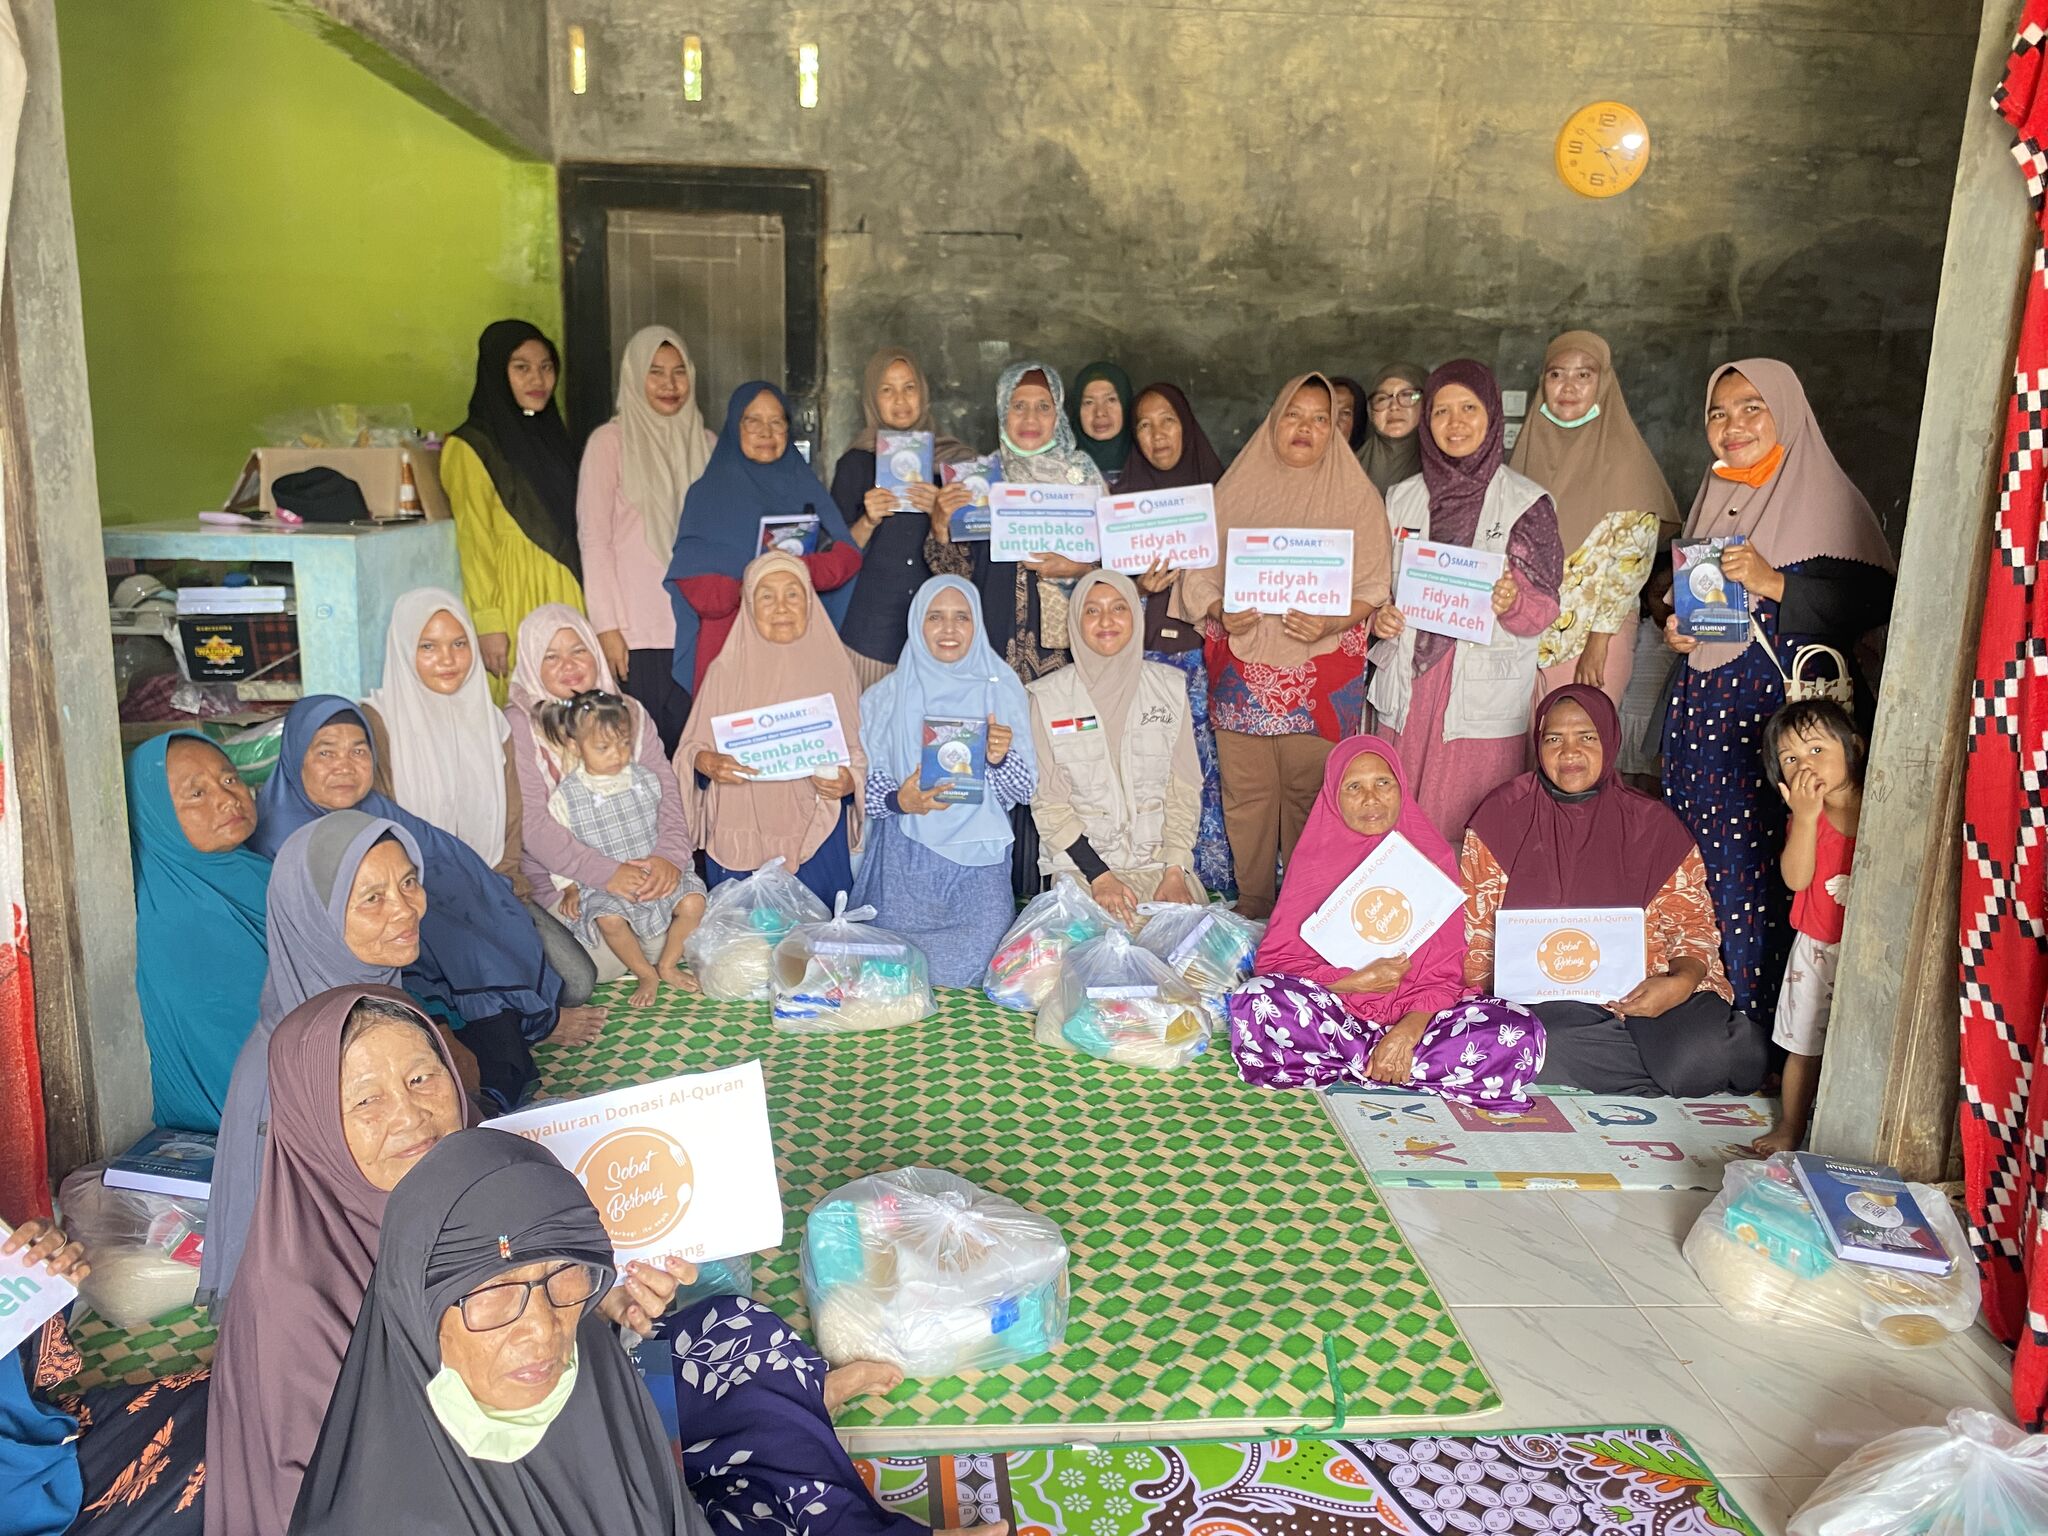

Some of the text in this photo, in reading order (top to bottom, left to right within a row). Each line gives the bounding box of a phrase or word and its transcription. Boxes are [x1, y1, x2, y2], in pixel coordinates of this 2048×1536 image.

[1008, 522, 1085, 536] Sembako
[1131, 530, 1186, 550] Fidyah
[1001, 537, 1095, 552] untuk Aceh
[1112, 545, 1209, 569] untuk Aceh
[1258, 570, 1318, 588] Fidyah
[1235, 588, 1341, 605] untuk Aceh
[1422, 586, 1469, 609] Fidyah
[1402, 603, 1485, 632] untuk Aceh
[740, 738, 825, 764] Sembako
[758, 750, 839, 776] tuk Aceh
[1508, 915, 1634, 926] Penyaluran Donasi Al-Quran
[1536, 988, 1602, 998] Aceh Tamiang
[519, 1078, 745, 1143] nyaluran Donasi Al-Quran
[604, 1150, 659, 1191] Sobat
[606, 1183, 669, 1223] Berbagi
[640, 1243, 705, 1266] amiang
[0, 1275, 42, 1317] eh
